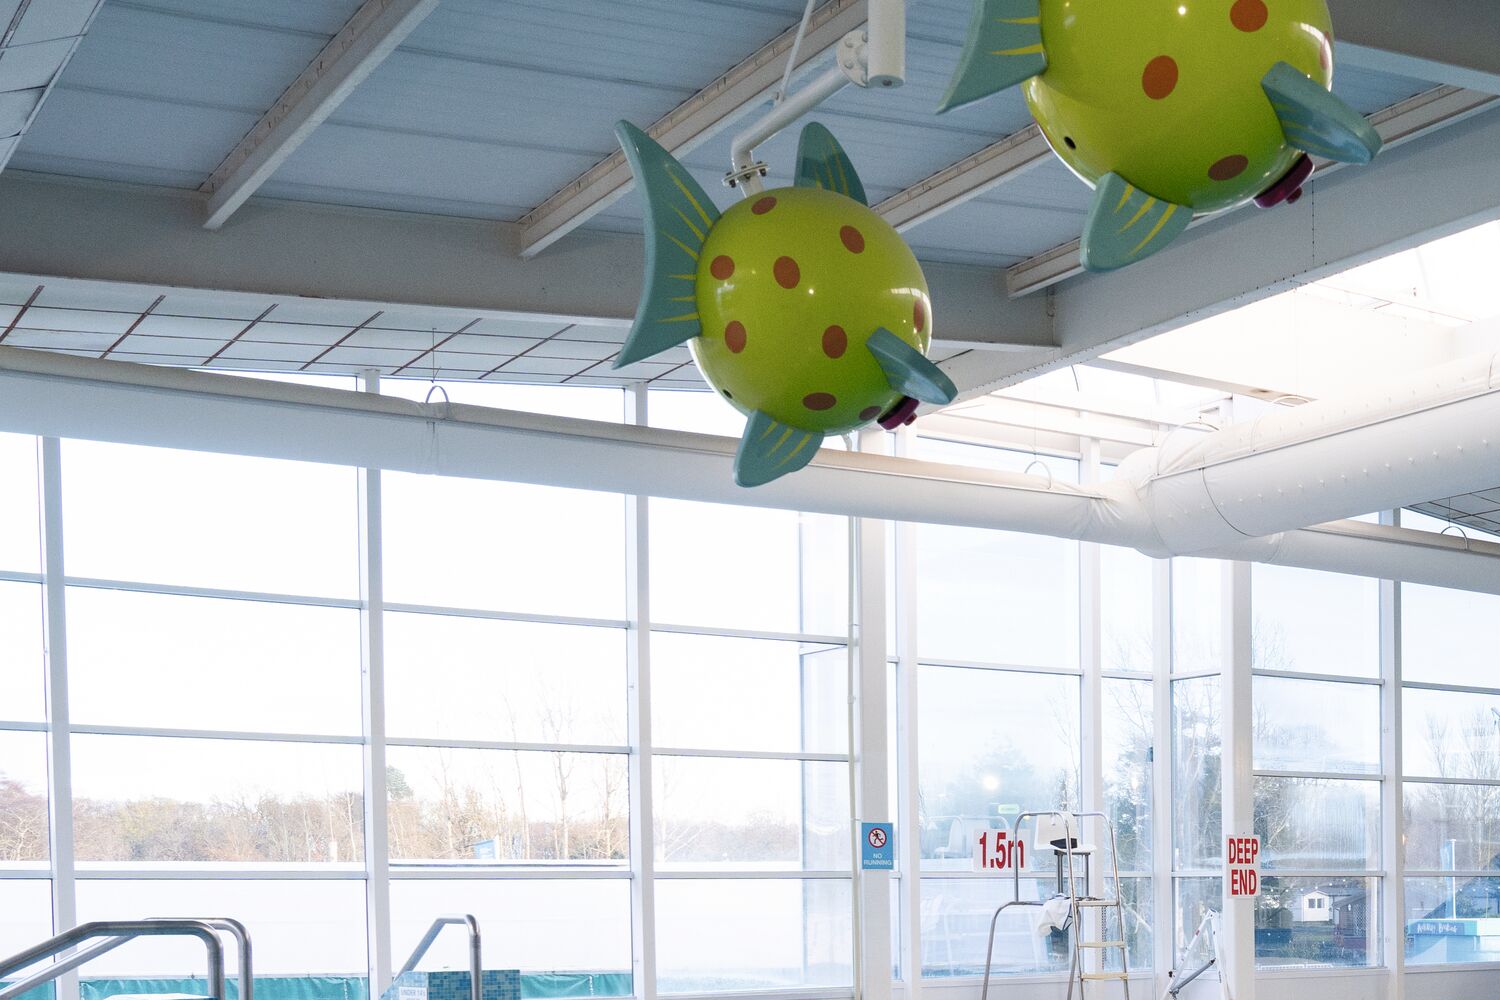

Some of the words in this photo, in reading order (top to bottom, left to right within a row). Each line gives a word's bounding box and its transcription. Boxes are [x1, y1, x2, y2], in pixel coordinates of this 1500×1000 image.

[979, 831, 1025, 869] 1.5m
[1228, 838, 1259, 864] DEEP
[1231, 869, 1257, 895] END
